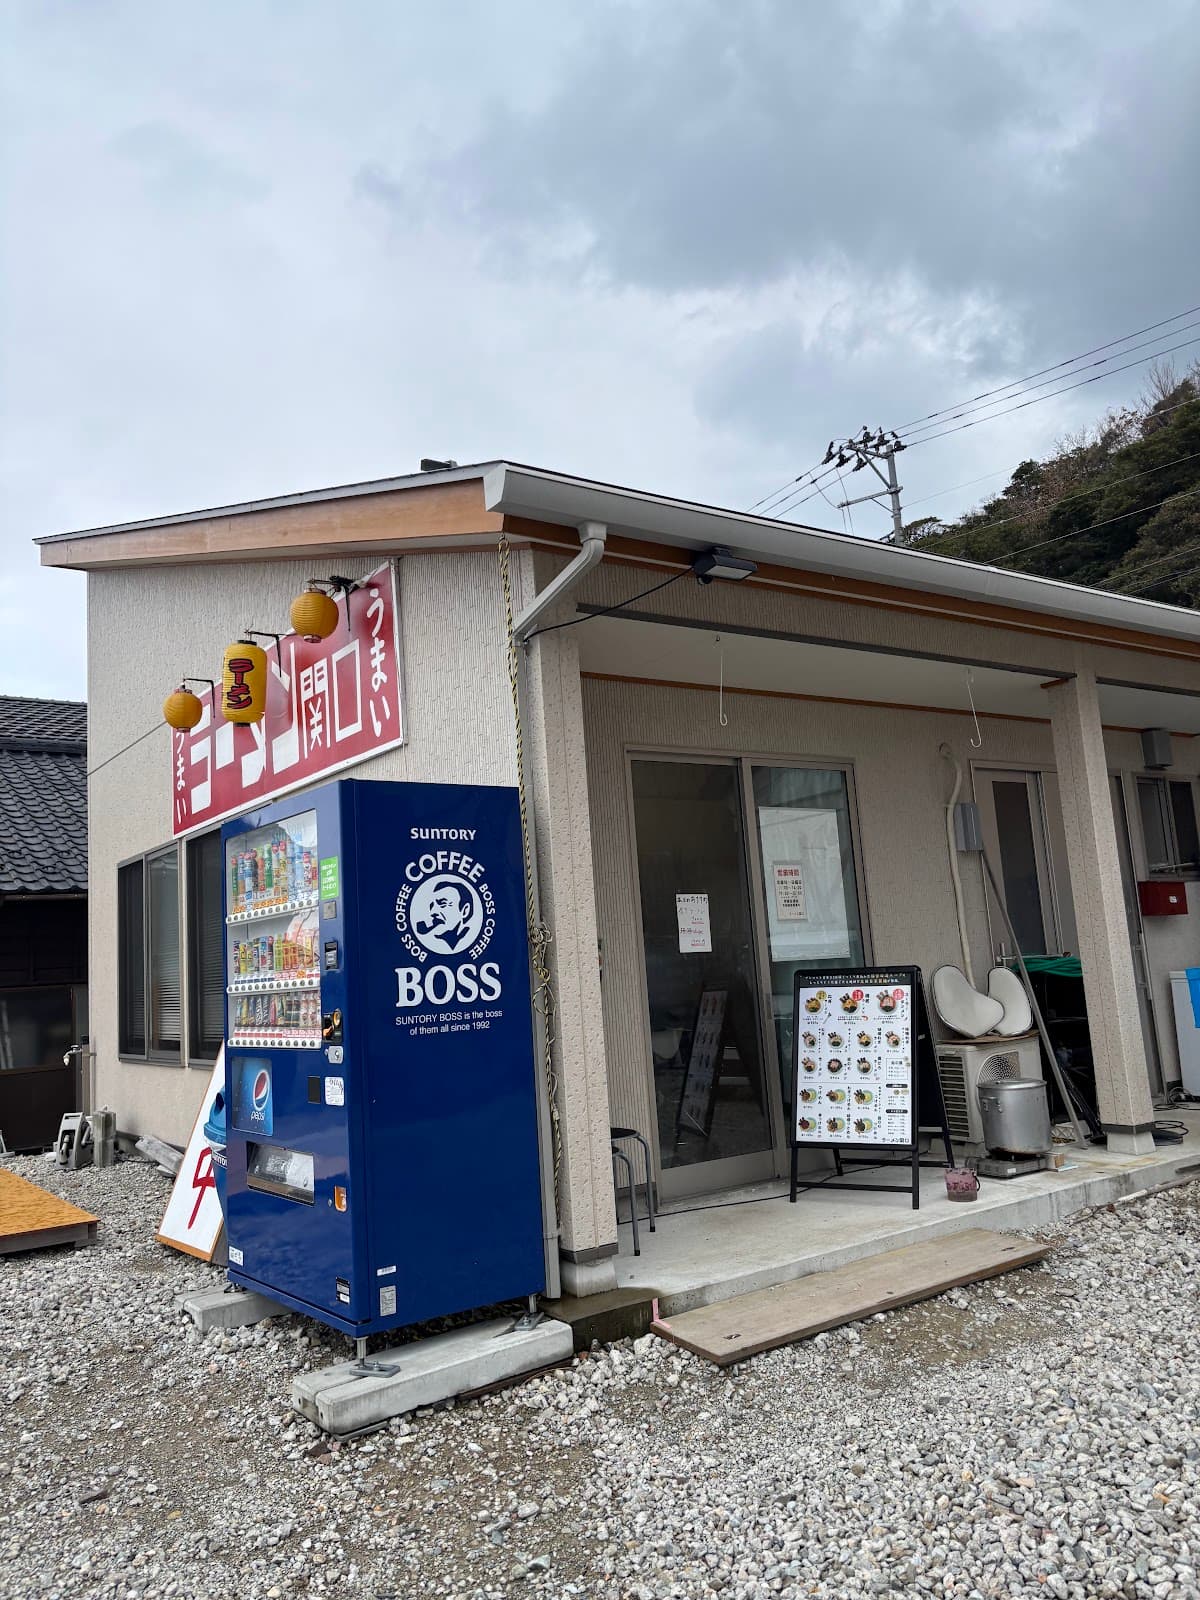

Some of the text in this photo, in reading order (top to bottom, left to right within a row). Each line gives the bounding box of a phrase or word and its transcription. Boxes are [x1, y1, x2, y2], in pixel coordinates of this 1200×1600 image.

[367, 588, 391, 738] うまい
[175, 732, 187, 824] うまい
[410, 827, 477, 840] SUNTORY
[405, 850, 485, 883] COFFEE
[395, 883, 428, 963] BOSS COFFEE
[468, 883, 496, 961] BOSS COFFEE
[394, 962, 502, 1008] BOSS
[395, 1009, 503, 1026] SUNTORY BOSS is the boss
[409, 1020, 490, 1036] of them all since 1992
[251, 1111, 265, 1123] pepsi
